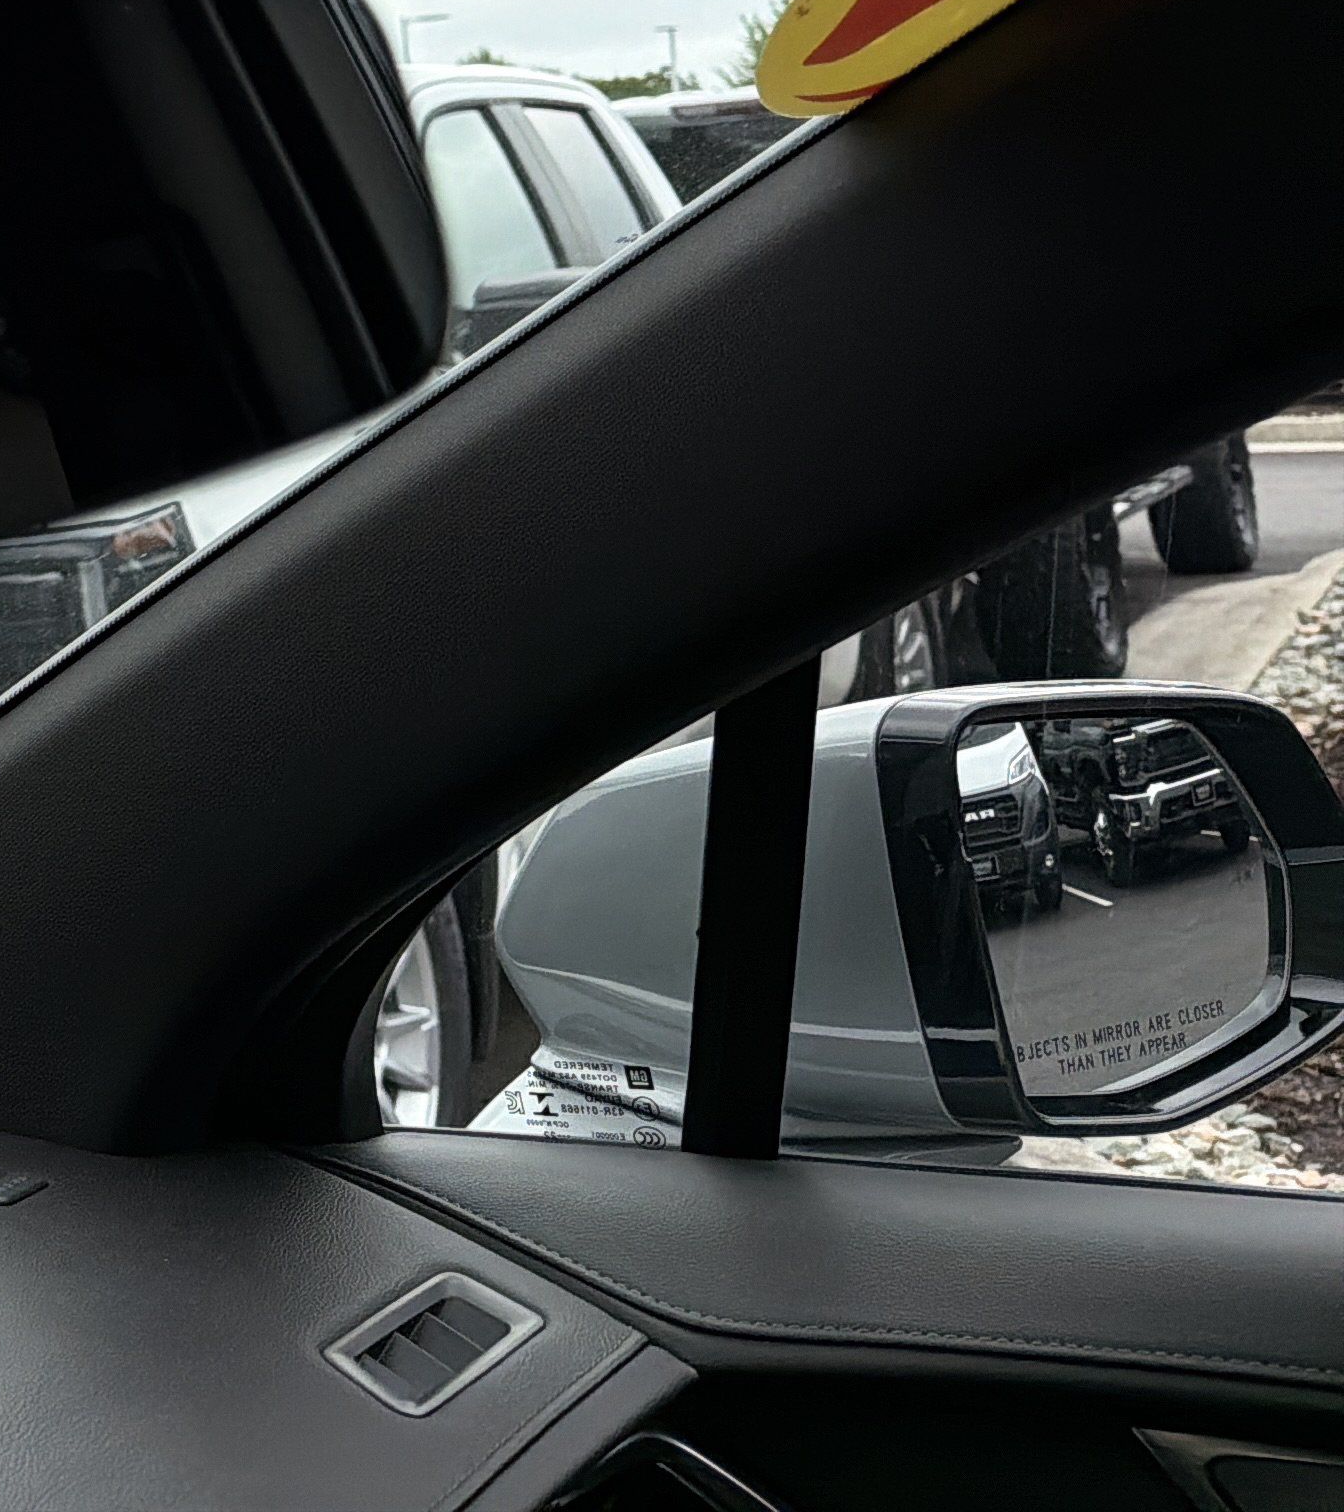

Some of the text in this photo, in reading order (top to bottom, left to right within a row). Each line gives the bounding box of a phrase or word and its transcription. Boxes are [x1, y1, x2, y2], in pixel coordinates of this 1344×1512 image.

[1016, 999, 1225, 1063] BJECTS IN MIRROR ARE CLOSER
[1058, 1032, 1188, 1075] THAN THEY APPEAR
